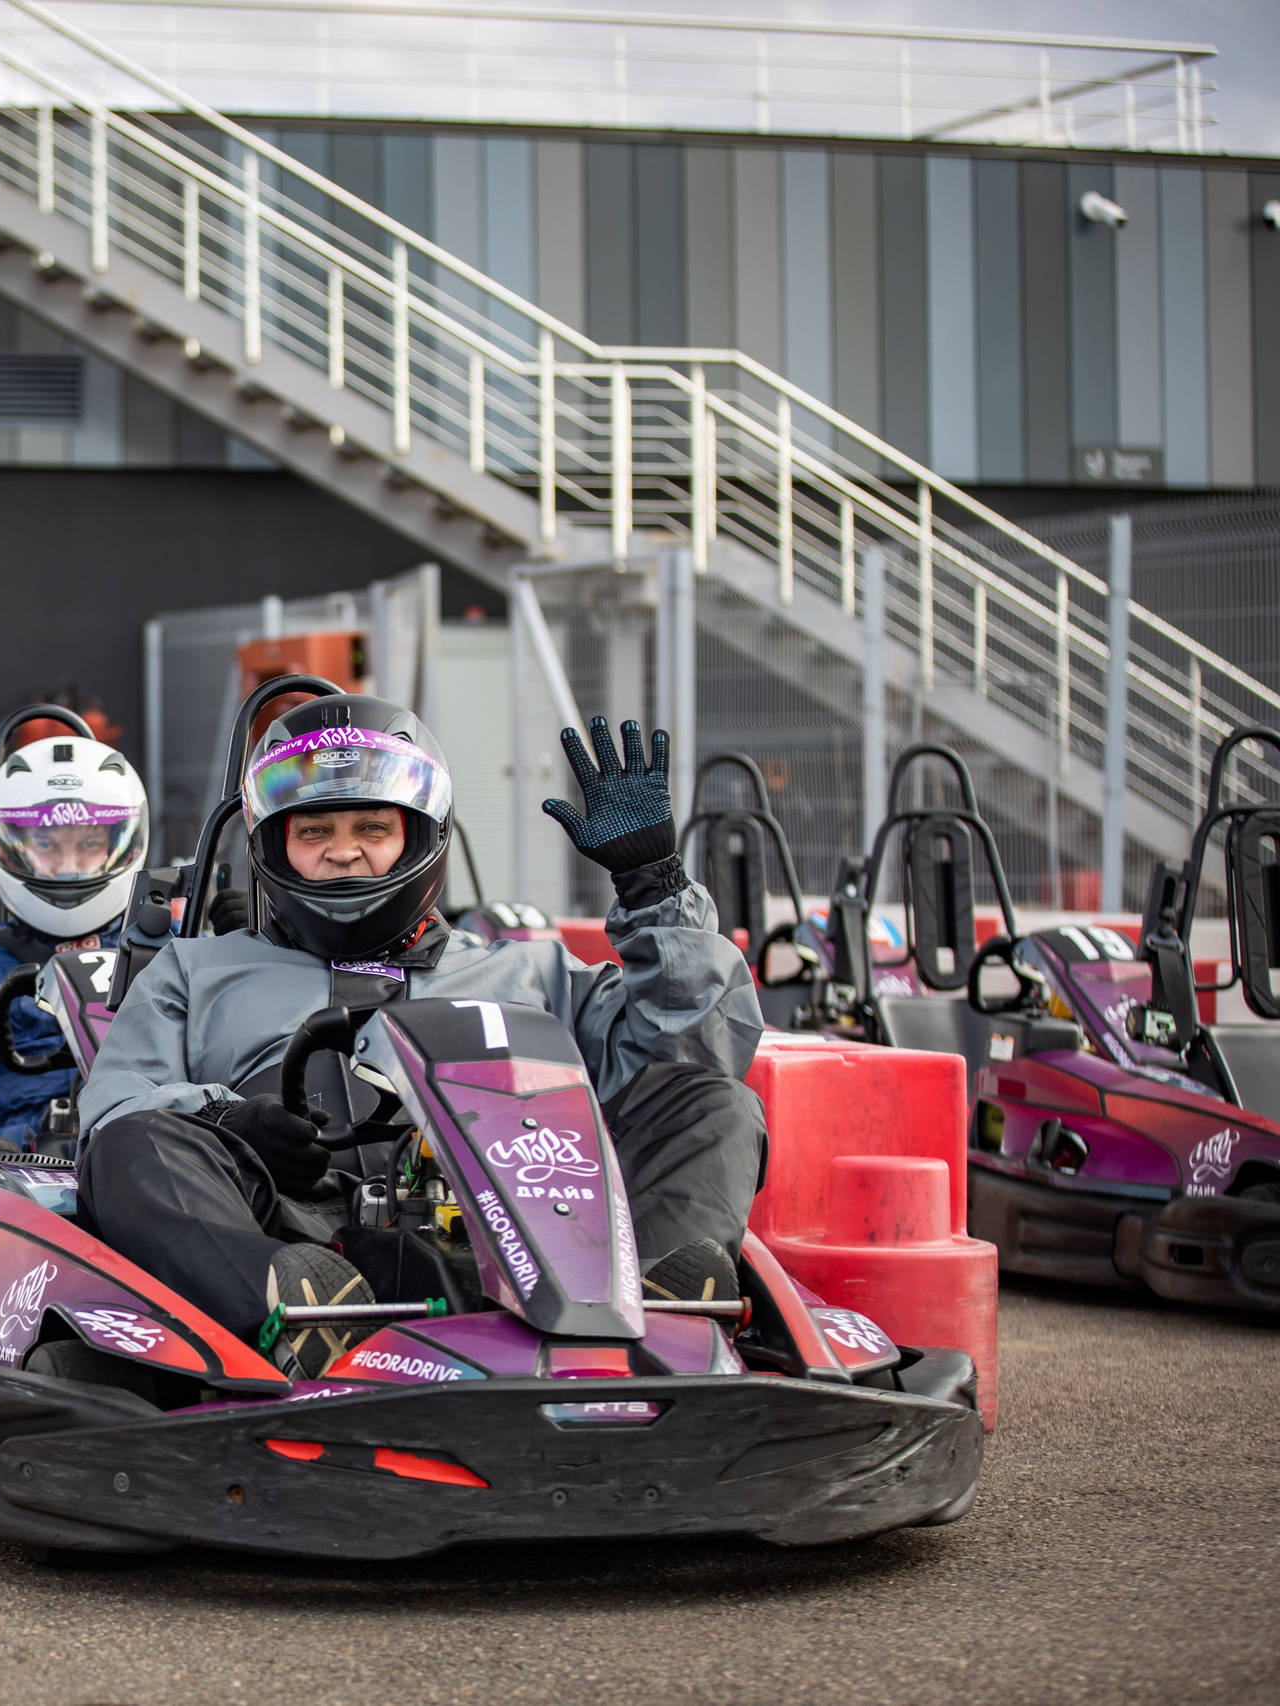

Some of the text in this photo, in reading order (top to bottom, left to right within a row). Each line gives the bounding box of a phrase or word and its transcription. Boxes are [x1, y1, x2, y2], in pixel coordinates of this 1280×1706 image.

[516, 1185, 595, 1200] ДРАЙВ
[476, 1189, 539, 1299] #IGORADRIV
[614, 1192, 638, 1308] #IGORADRIVE
[350, 1349, 464, 1382] #IGORADRIVE
